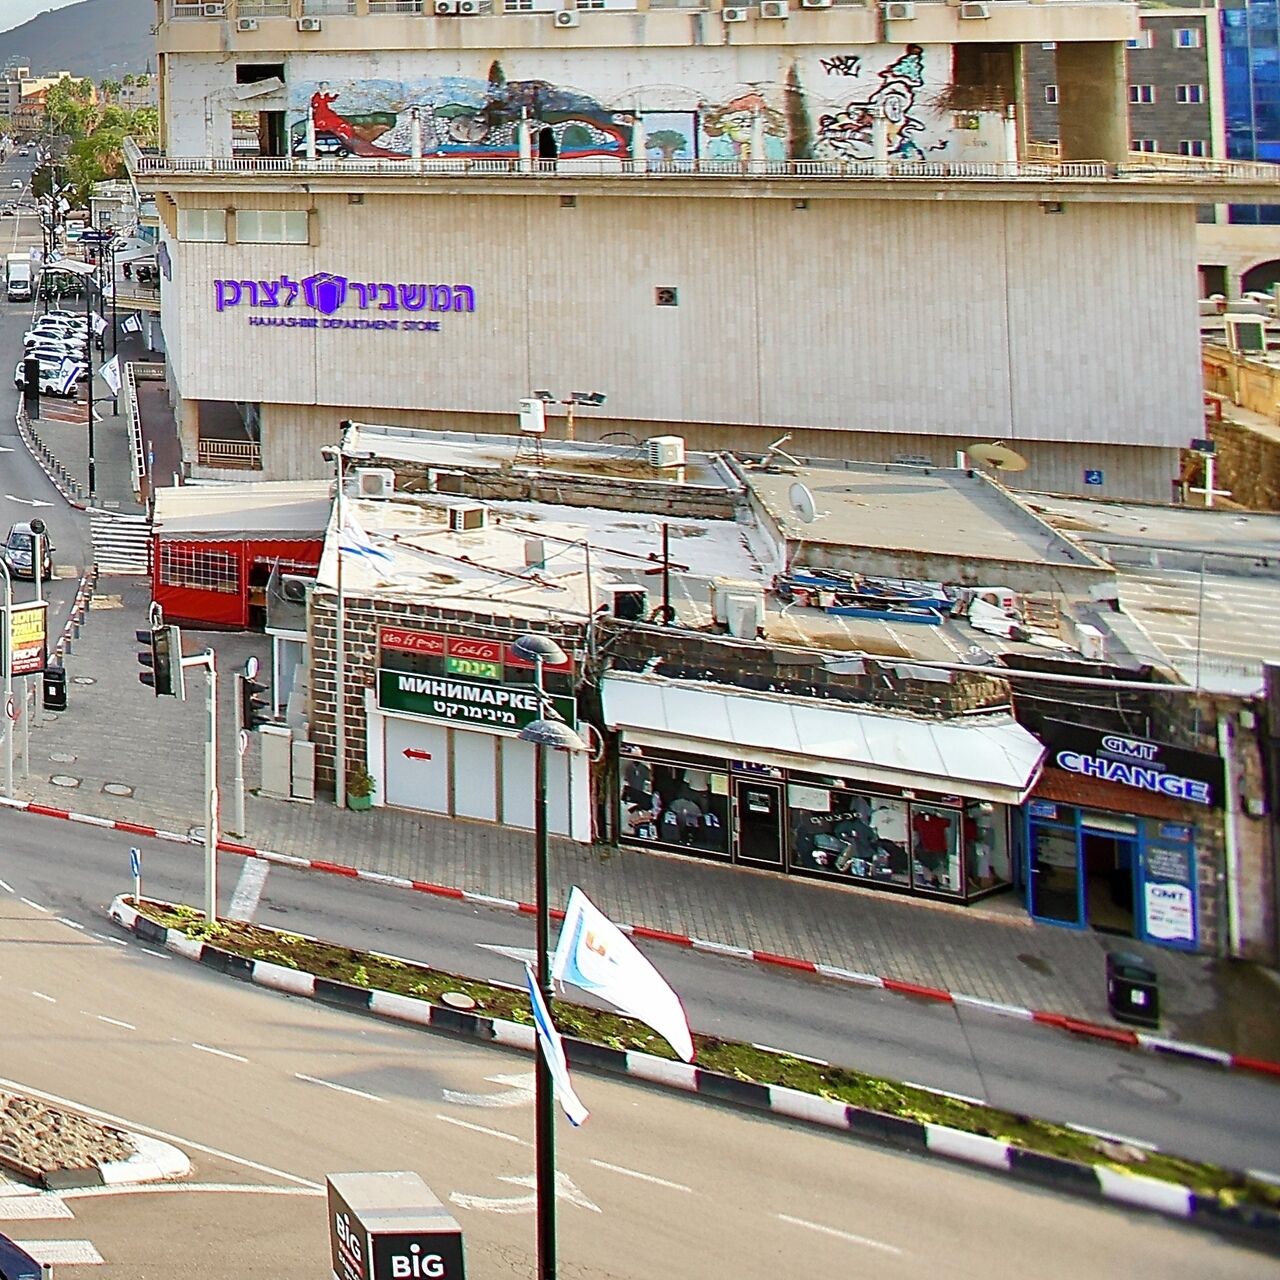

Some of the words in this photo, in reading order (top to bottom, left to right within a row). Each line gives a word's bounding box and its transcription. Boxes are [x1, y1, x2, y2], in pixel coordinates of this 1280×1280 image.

[213, 274, 300, 312] לצרכן
[349, 282, 476, 313] המשביר
[322, 318, 400, 331] DEPARTMENT
[401, 320, 441, 333] STORE
[398, 675, 544, 712] МИНИМАРКЕ
[433, 700, 517, 725] מינימרקט
[1101, 735, 1159, 761] GMT
[1056, 751, 1210, 804] CHANGE
